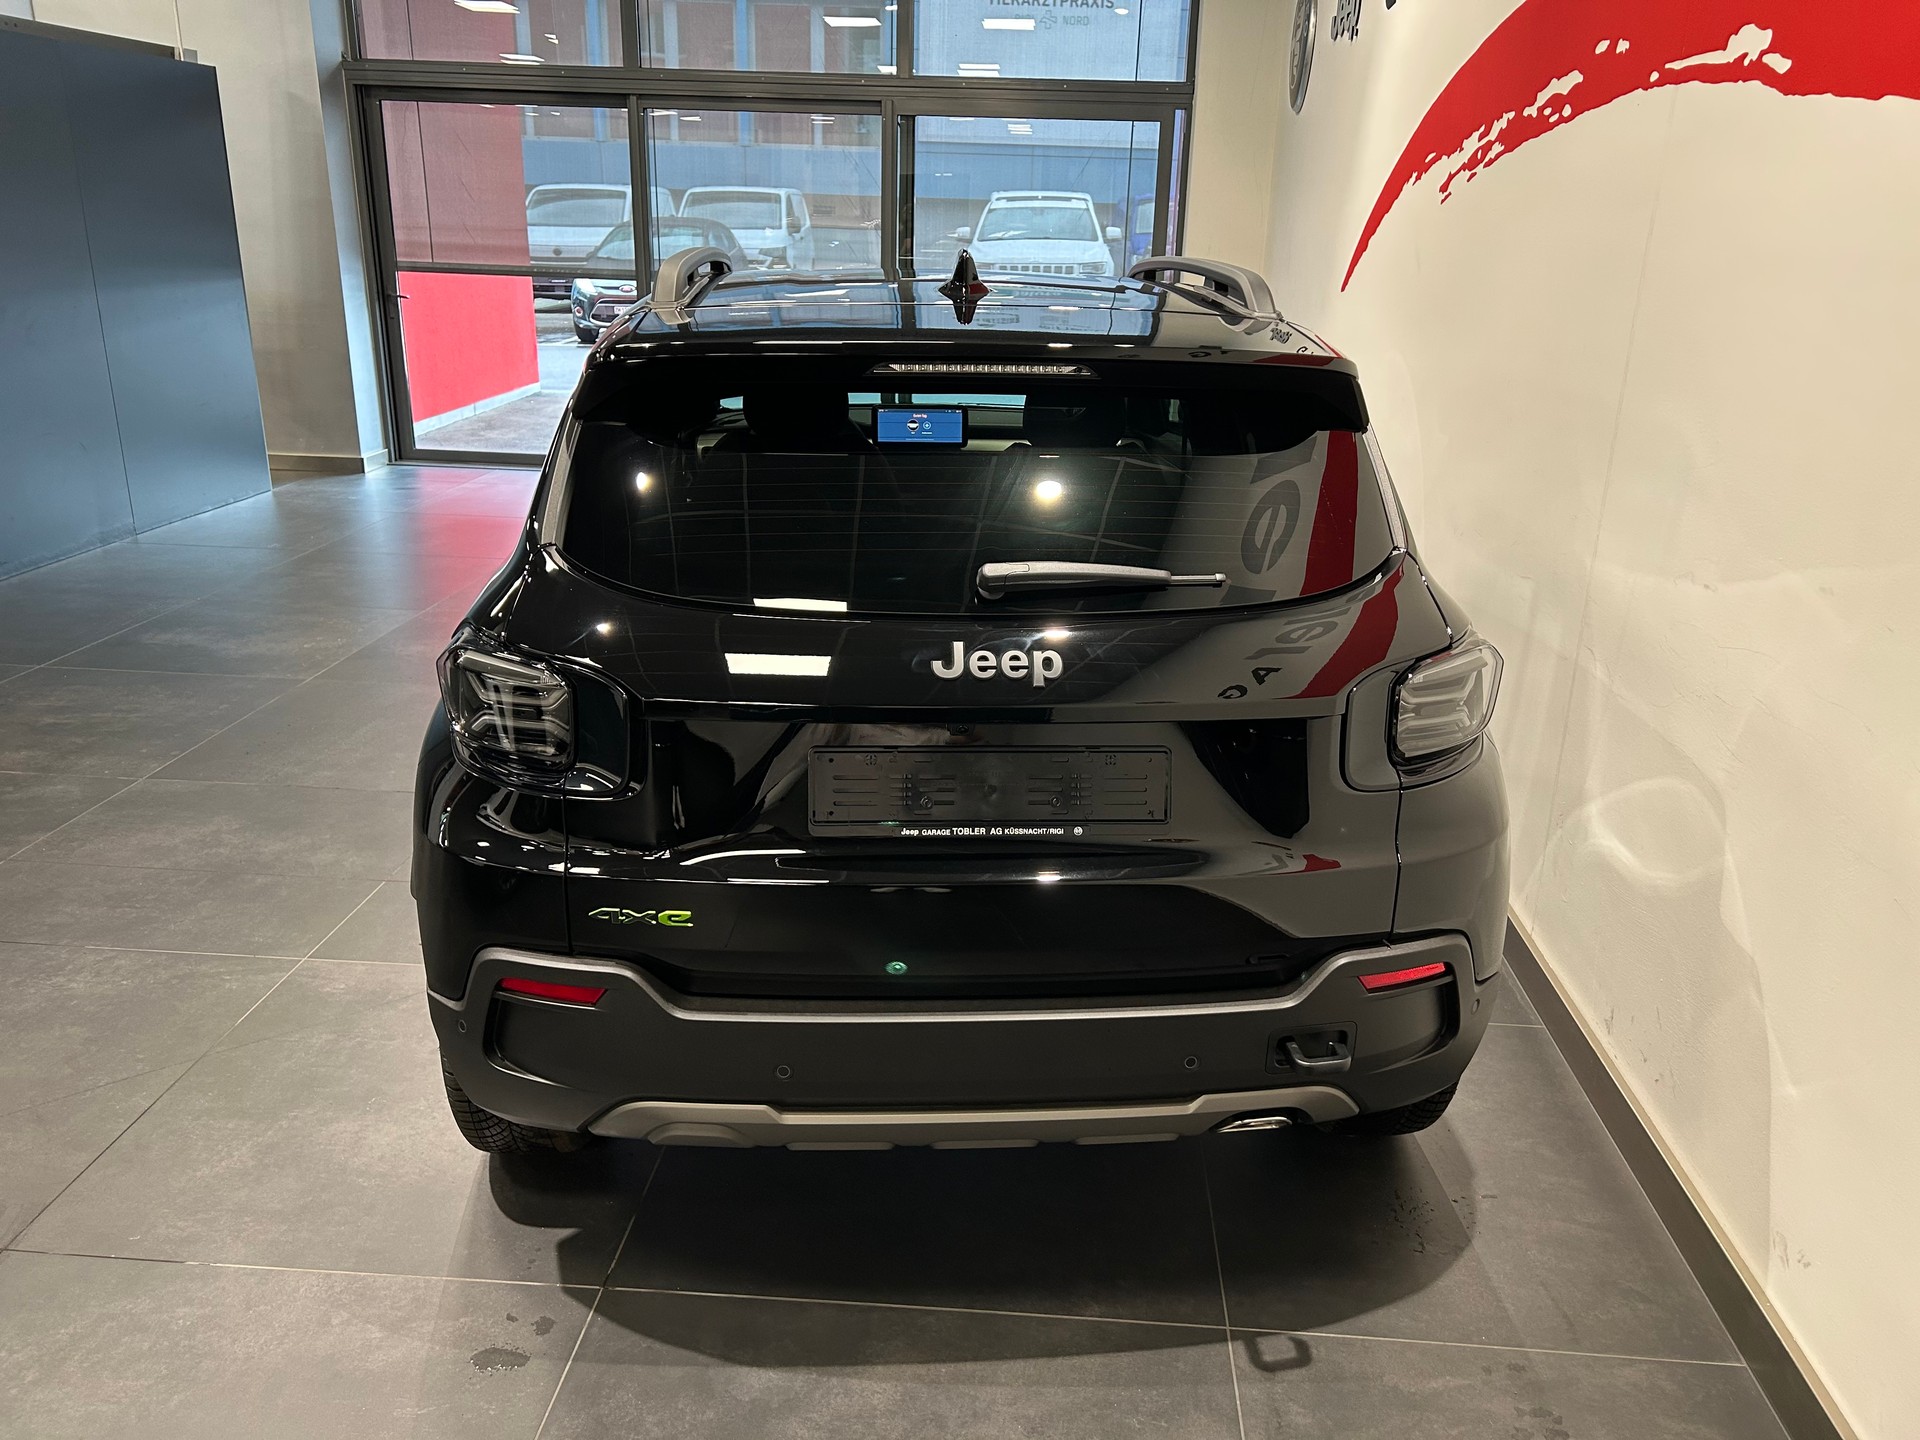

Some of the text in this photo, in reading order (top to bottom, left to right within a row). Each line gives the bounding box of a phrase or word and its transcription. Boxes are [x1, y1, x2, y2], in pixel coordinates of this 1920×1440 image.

[1062, 15, 1090, 26] NORD
[931, 642, 1063, 687] Jeep
[900, 827, 920, 837] Jeep
[952, 827, 986, 835] TOBLER
[989, 827, 1003, 835] AG
[1004, 826, 1064, 835] KÜSSNACHT/RIGI
